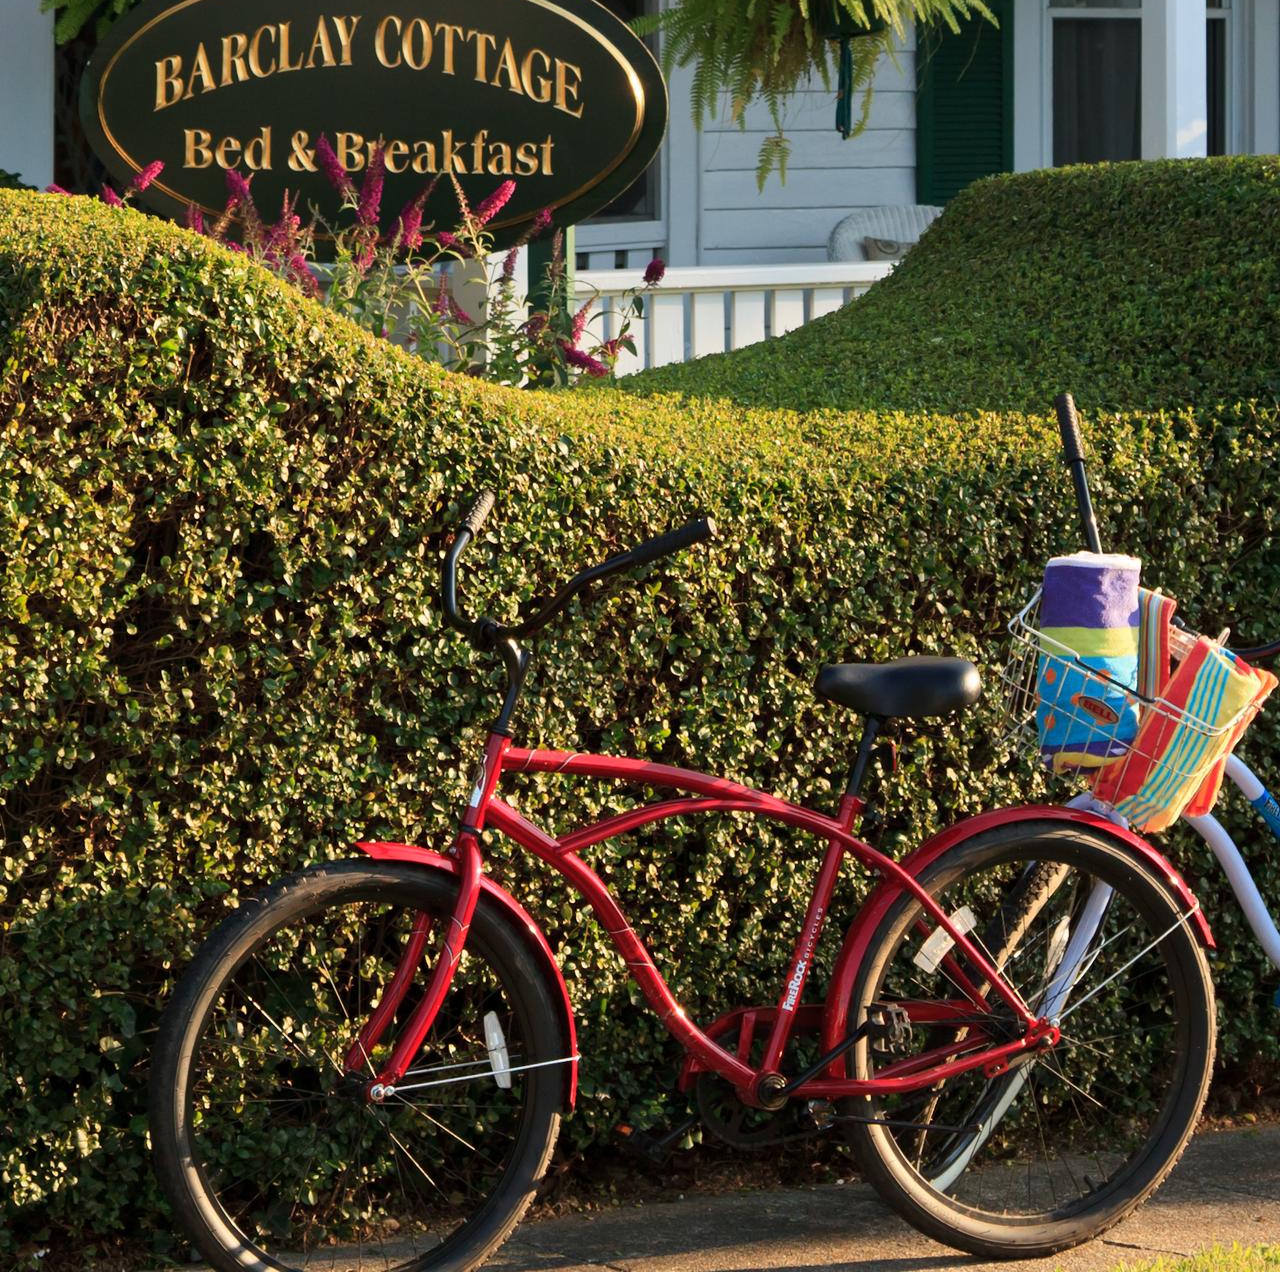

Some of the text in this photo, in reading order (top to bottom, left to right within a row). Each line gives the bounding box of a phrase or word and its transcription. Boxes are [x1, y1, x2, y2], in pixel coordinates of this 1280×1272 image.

[153, 14, 584, 119] BARCLAY COTTAGE
[182, 126, 555, 176] Bed & Breakfast
[1083, 699, 1114, 722] BELL
[803, 907, 824, 959] BICYCLES
